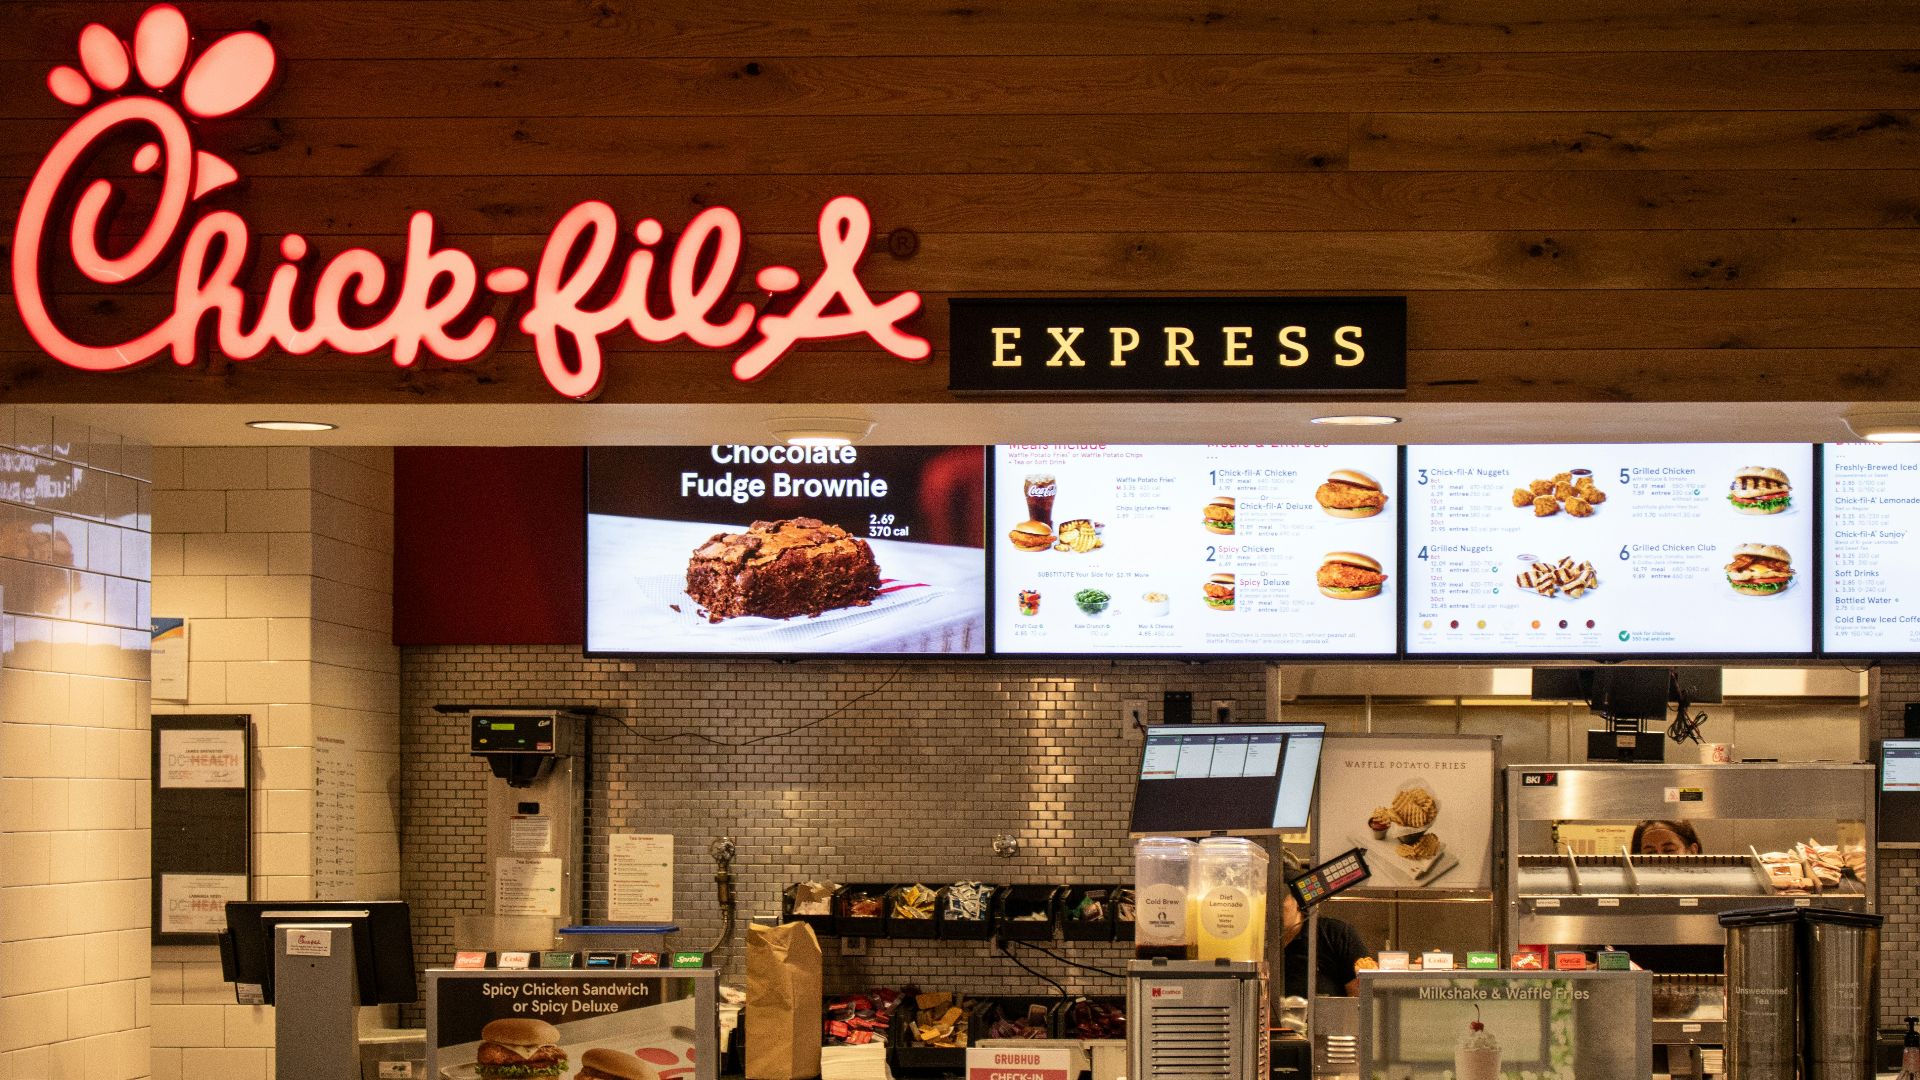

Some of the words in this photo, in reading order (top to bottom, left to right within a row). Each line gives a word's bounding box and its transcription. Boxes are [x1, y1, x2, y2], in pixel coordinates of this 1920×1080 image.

[991, 325, 1366, 367] EXPRESS
[711, 445, 857, 464] Chocolate
[1430, 468, 1473, 476] Chick-fil-A
[1476, 468, 1510, 477] Nuggets
[1632, 467, 1660, 475] Grilled
[1662, 467, 1695, 475] Chicken
[1835, 464, 1898, 472] Freshly-Brewed
[1209, 470, 1216, 486] 1
[1418, 469, 1428, 485] 3
[1619, 468, 1630, 484] 5
[681, 472, 766, 503] Fudge
[773, 472, 888, 498] Brownie
[869, 515, 895, 525] 2.69
[869, 526, 891, 537] 370
[893, 526, 909, 537] cal
[1879, 531, 1905, 539] Sunjoy
[1205, 546, 1216, 562] 2
[1218, 545, 1239, 554] Spicy
[1418, 545, 1429, 562] 4
[1460, 545, 1493, 553] Nuggets
[1619, 544, 1630, 561] 6
[1240, 578, 1261, 587] Spicy
[1263, 578, 1290, 586] Deluxe
[190, 754, 239, 767] HEALTH
[1345, 761, 1385, 770] WAFFLE
[1390, 761, 1430, 770] POTATO
[1435, 761, 1467, 770] FRIES
[1526, 776, 1541, 784] BKI
[677, 955, 702, 963] Sprite
[1471, 956, 1496, 964] Sprite
[482, 983, 519, 998] Spicy
[522, 983, 580, 996] Chicken
[583, 983, 649, 996] Sandwich
[1419, 986, 1488, 1000] Milkshake
[1491, 986, 1502, 1000] &
[1506, 986, 1552, 1000] Waffle
[1555, 986, 1590, 1000] Fries
[1735, 986, 1789, 995] Unsweetened
[513, 1003, 529, 1013] or
[531, 1000, 568, 1016] Spicy
[572, 1000, 619, 1013] Deluxe
[994, 1054, 1041, 1065] GRUBHUB
